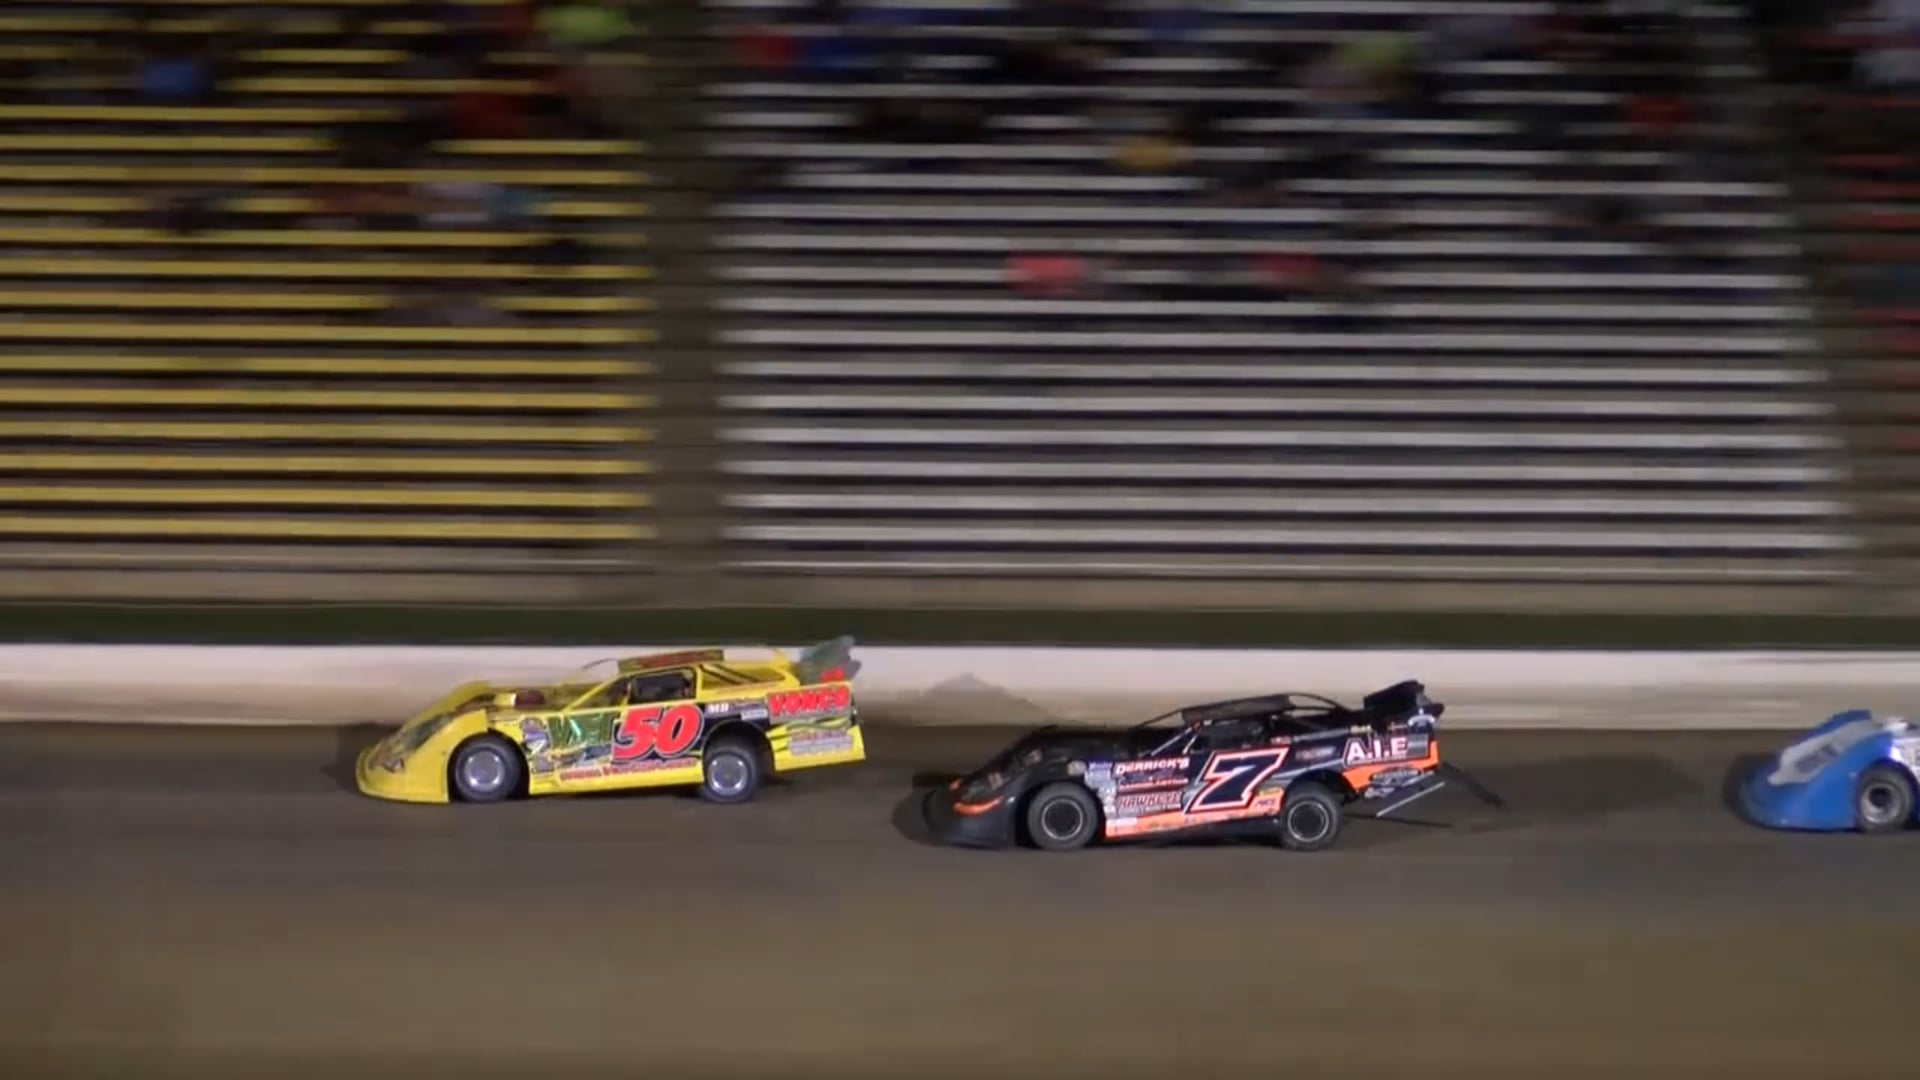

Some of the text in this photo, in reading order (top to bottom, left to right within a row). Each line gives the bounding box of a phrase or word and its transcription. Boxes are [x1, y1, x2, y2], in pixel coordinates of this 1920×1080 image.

[612, 702, 704, 762] 50
[1115, 757, 1190, 775] DERRICK'S
[1189, 747, 1290, 812] 7
